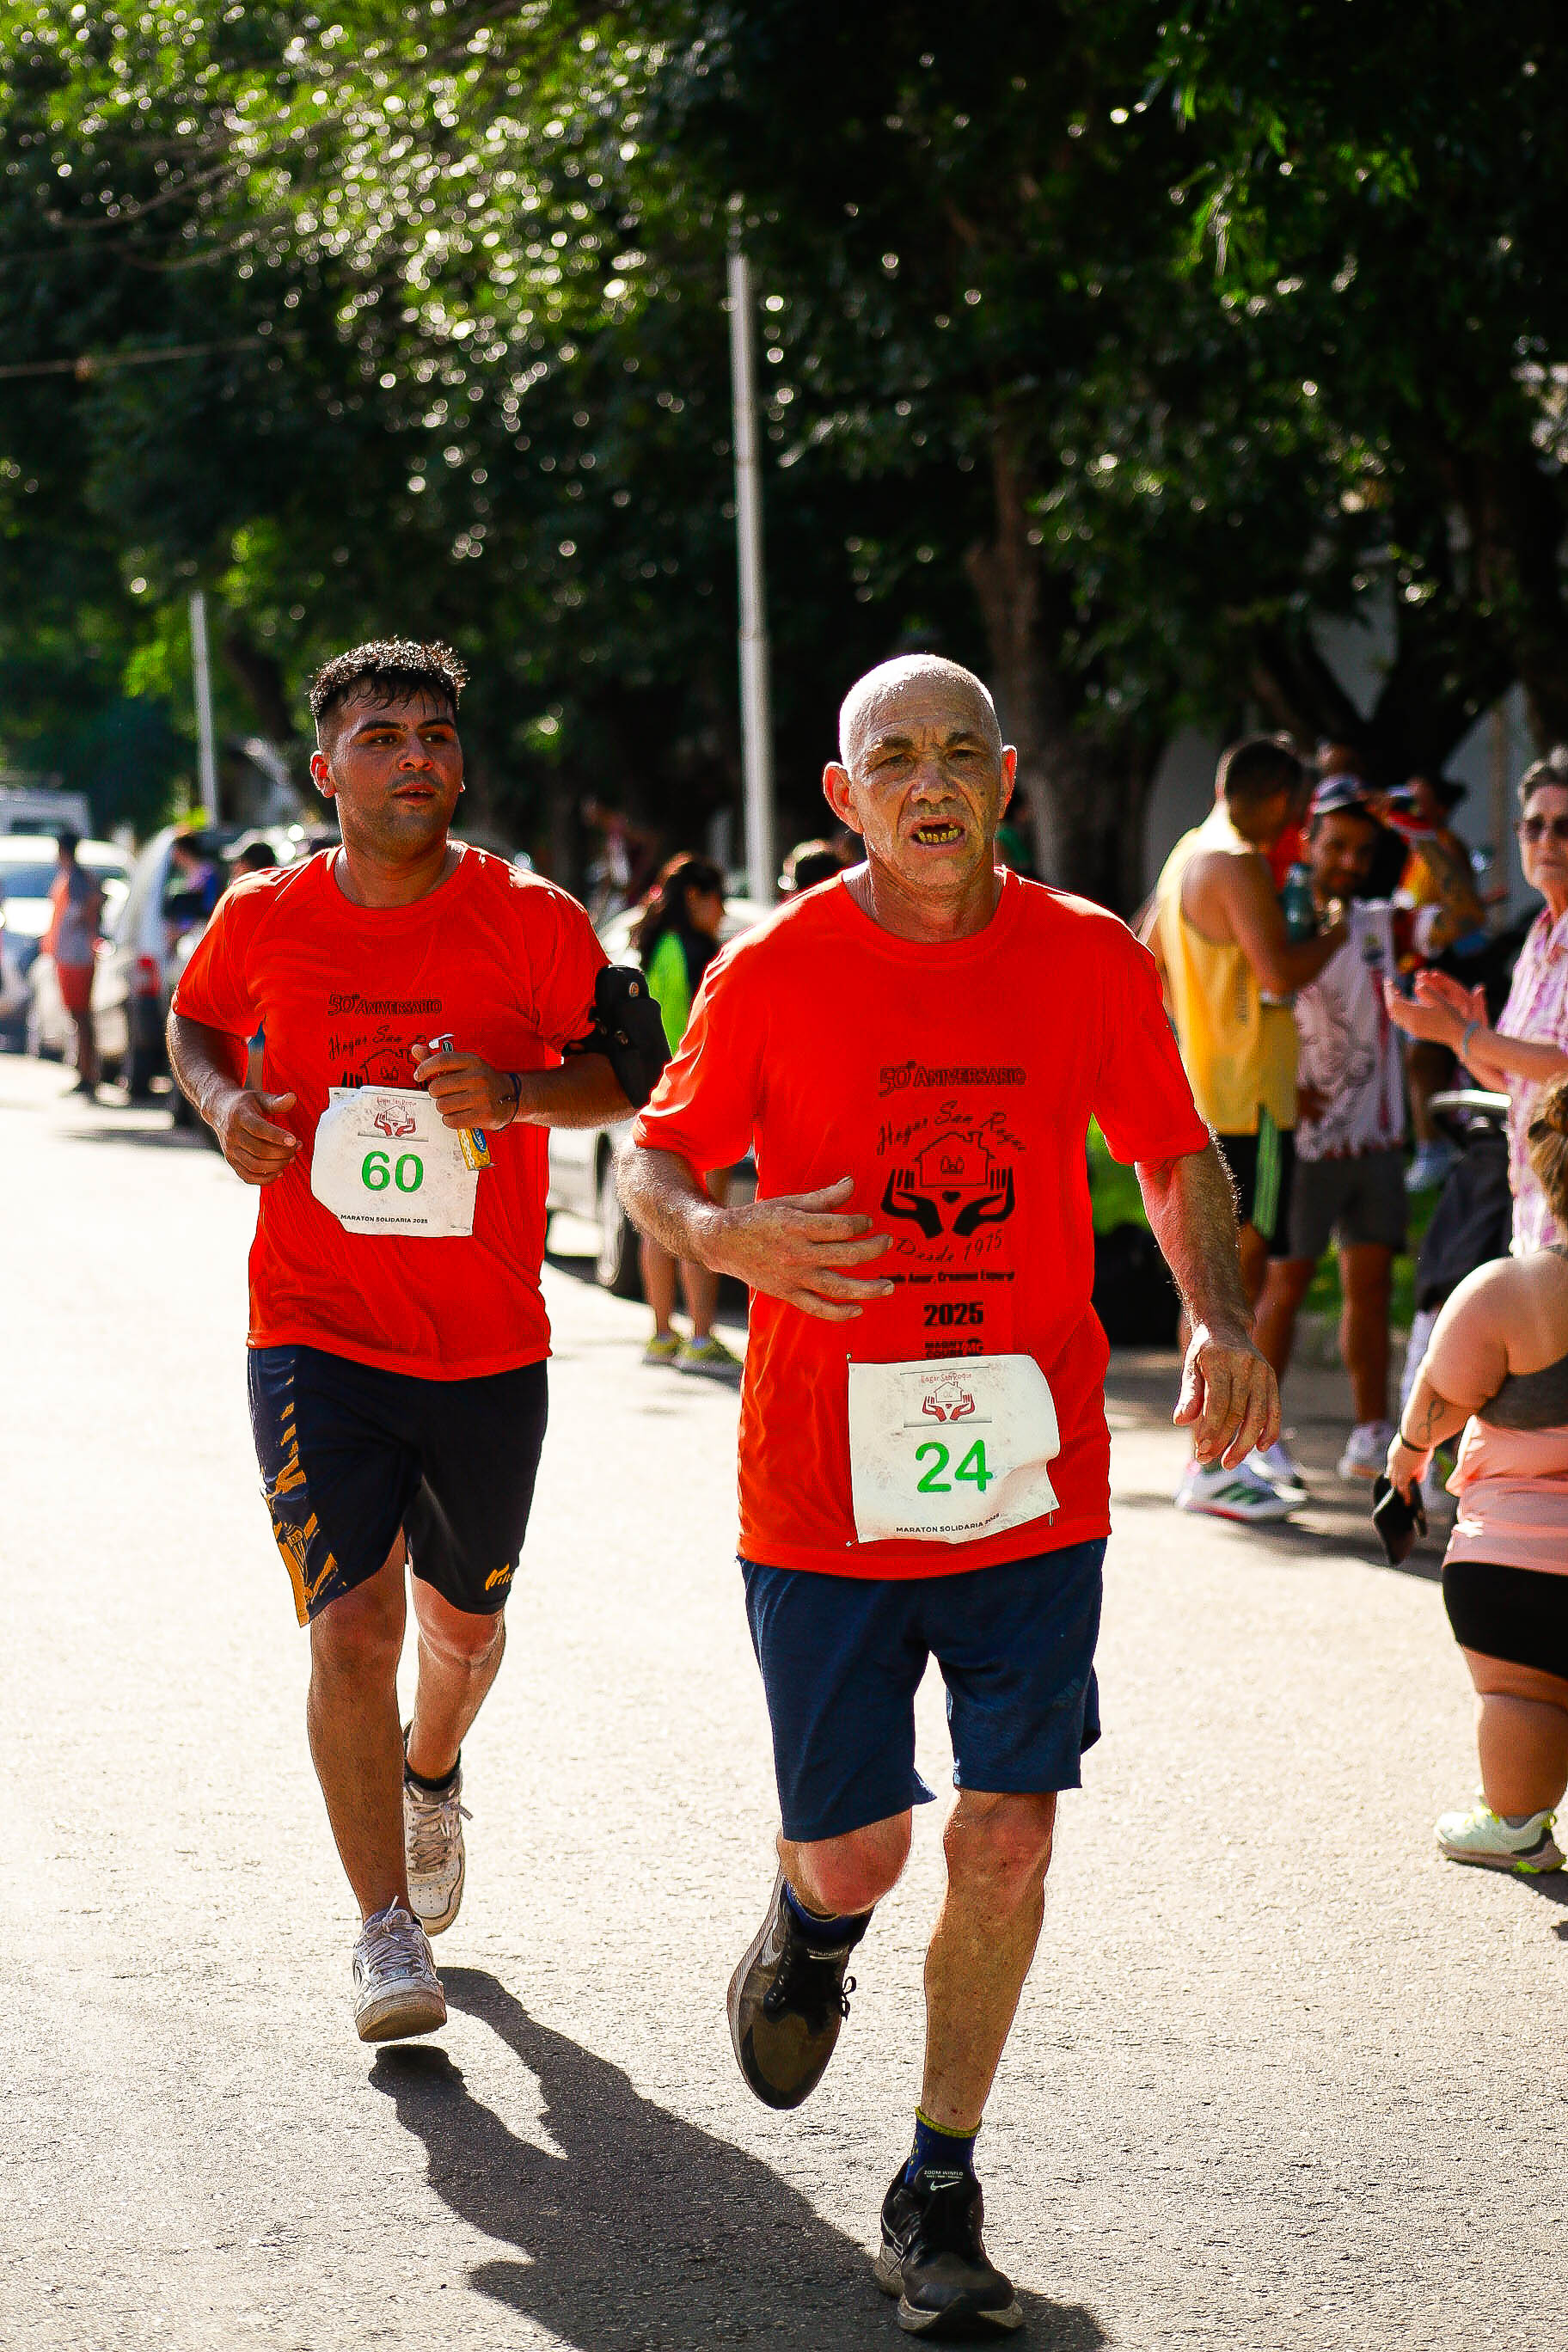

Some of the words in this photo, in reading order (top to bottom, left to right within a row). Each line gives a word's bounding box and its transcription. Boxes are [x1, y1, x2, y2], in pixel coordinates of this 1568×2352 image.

[361, 1151, 424, 1192] 60
[340, 1214, 375, 1222] MARATON
[963, 1228, 1003, 1262] 1975
[923, 1302, 983, 1326] 2025
[915, 1439, 994, 1493] 24
[940, 1522, 983, 1533] SOLIDARIA
